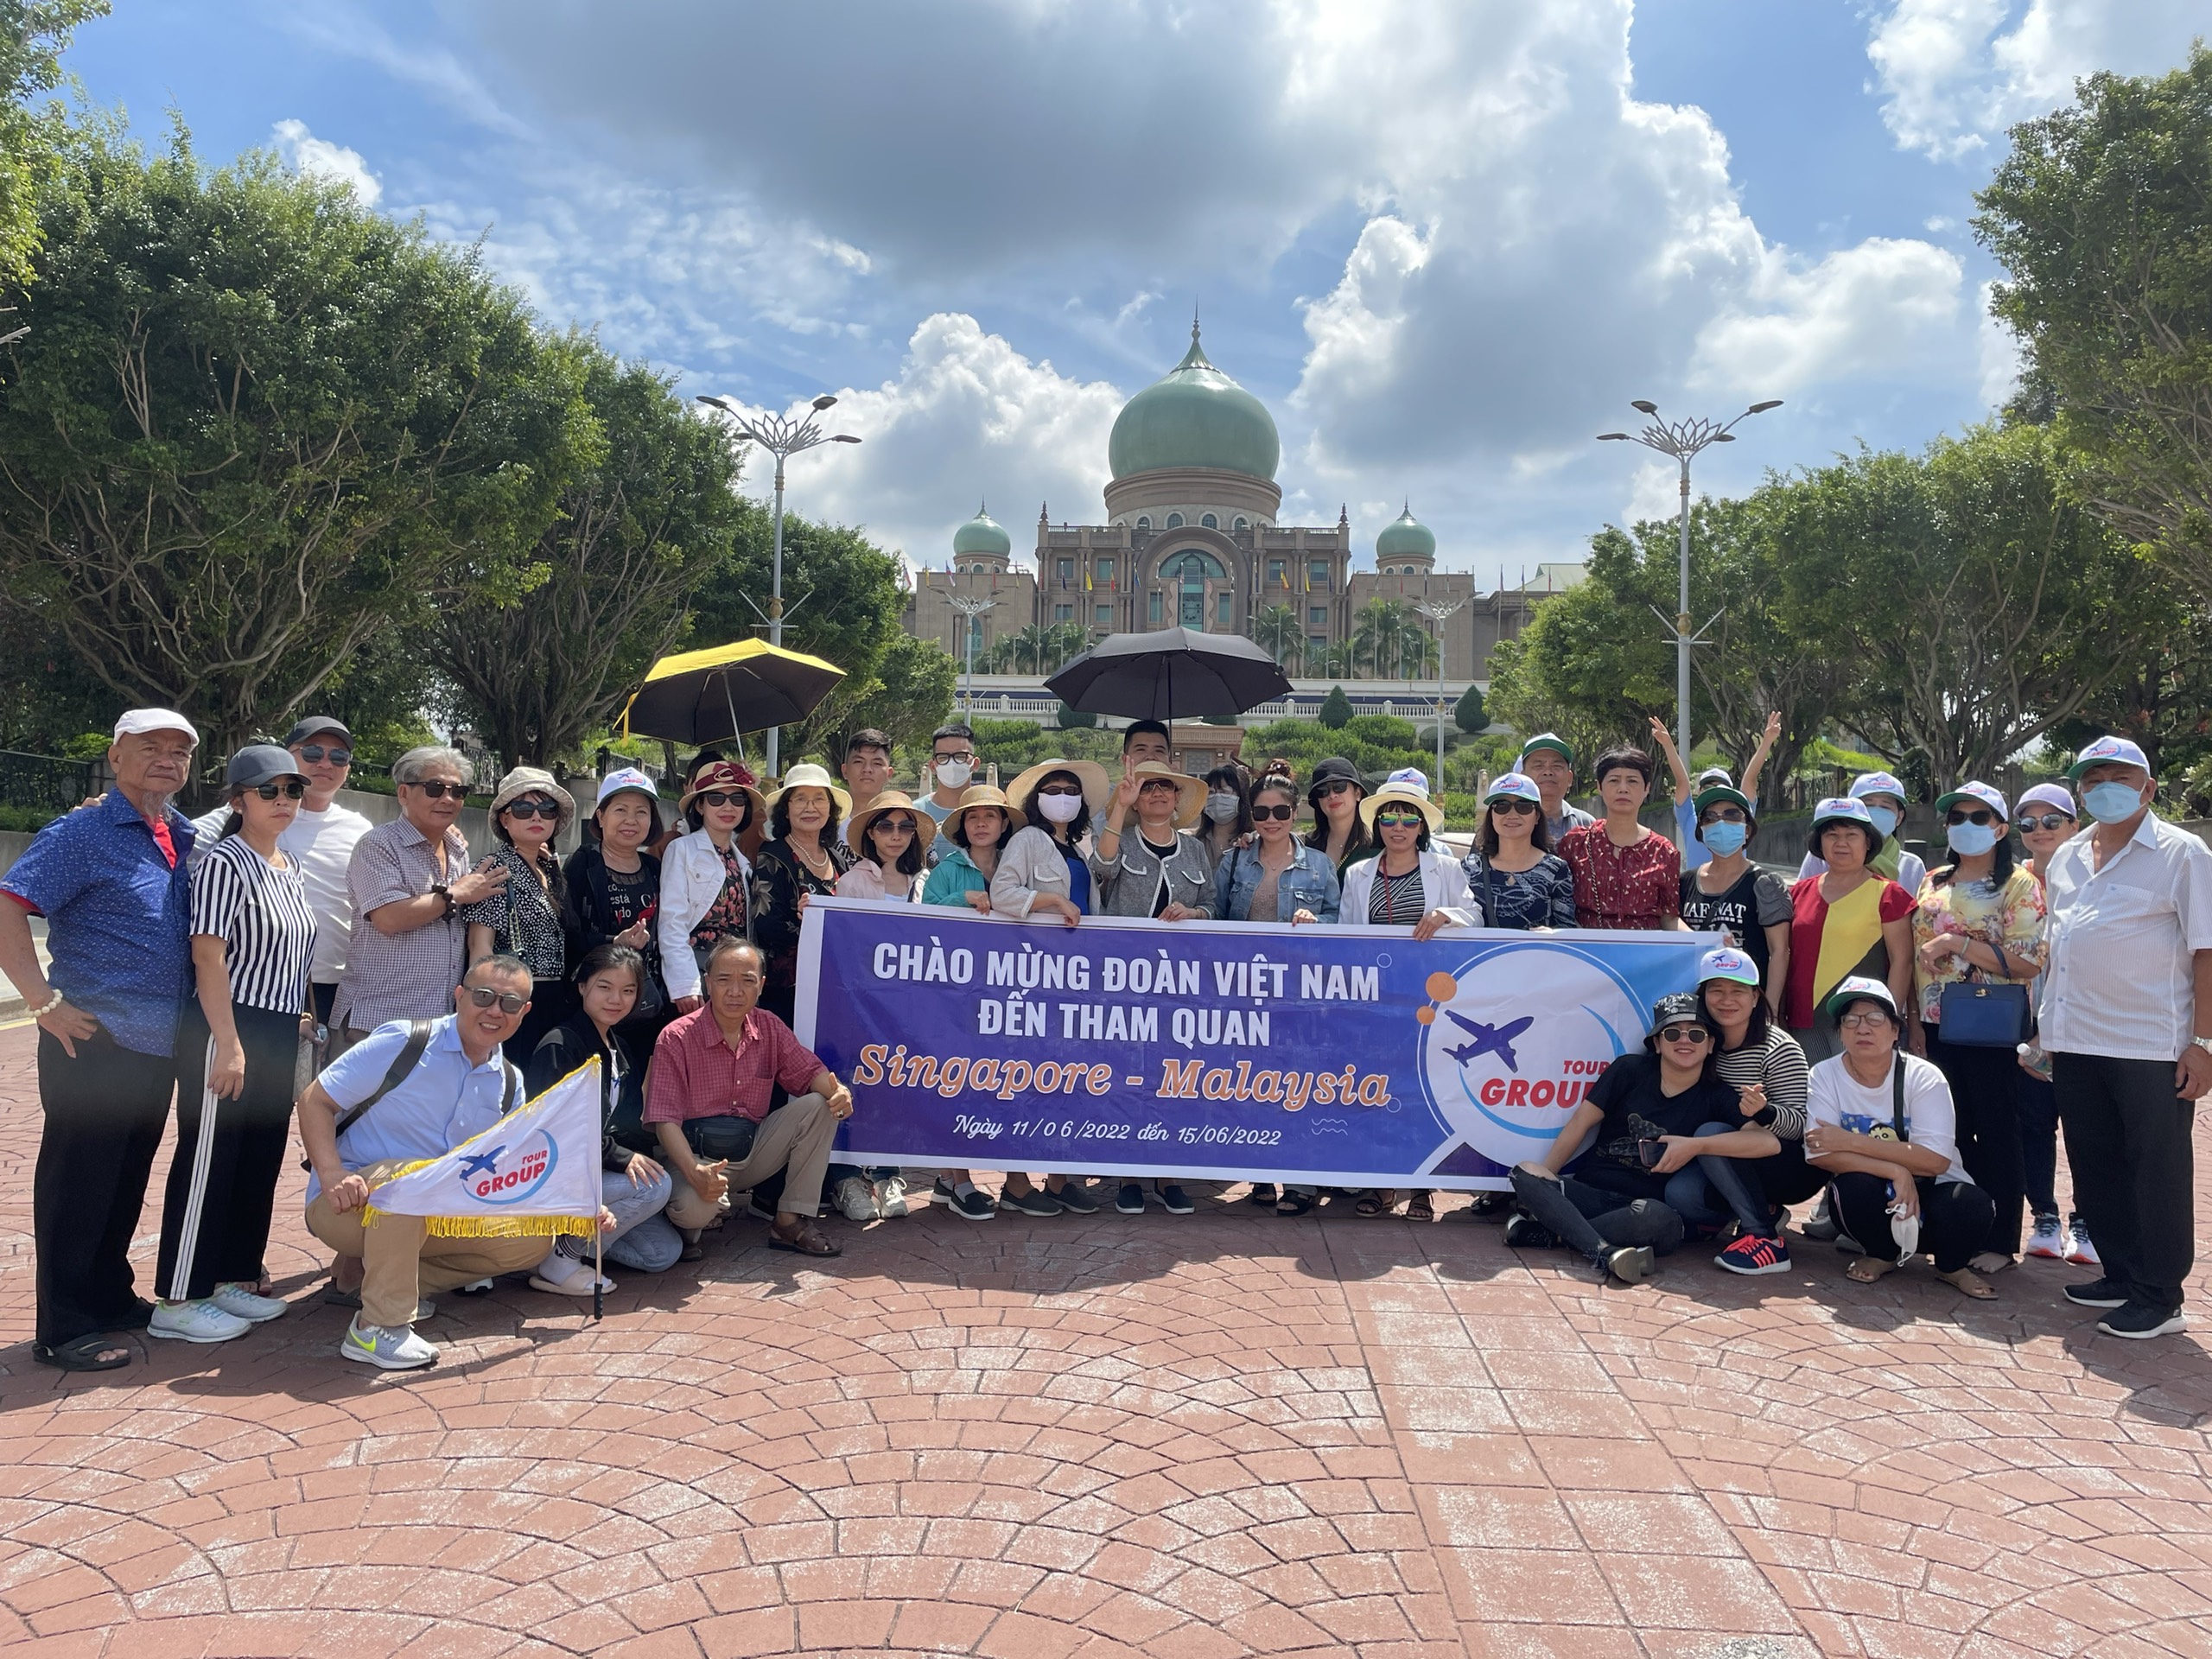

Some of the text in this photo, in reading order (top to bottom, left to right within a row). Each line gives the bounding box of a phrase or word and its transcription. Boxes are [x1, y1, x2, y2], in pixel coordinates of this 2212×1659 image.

[874, 936, 1379, 1006] CHÀO MỪNG ĐOÀN VIỆT NAM
[977, 988, 1270, 1050] ĐẾN THAM QUAN
[853, 1044, 1113, 1100] Singapore
[1156, 1059, 1392, 1112] Malaysia
[953, 1115, 1003, 1140] Ngày
[1137, 1122, 1170, 1141] đến
[1178, 1126, 1282, 1146] 15/06/2022
[476, 1162, 546, 1197] GROUP
[522, 1150, 548, 1164] TOUR
